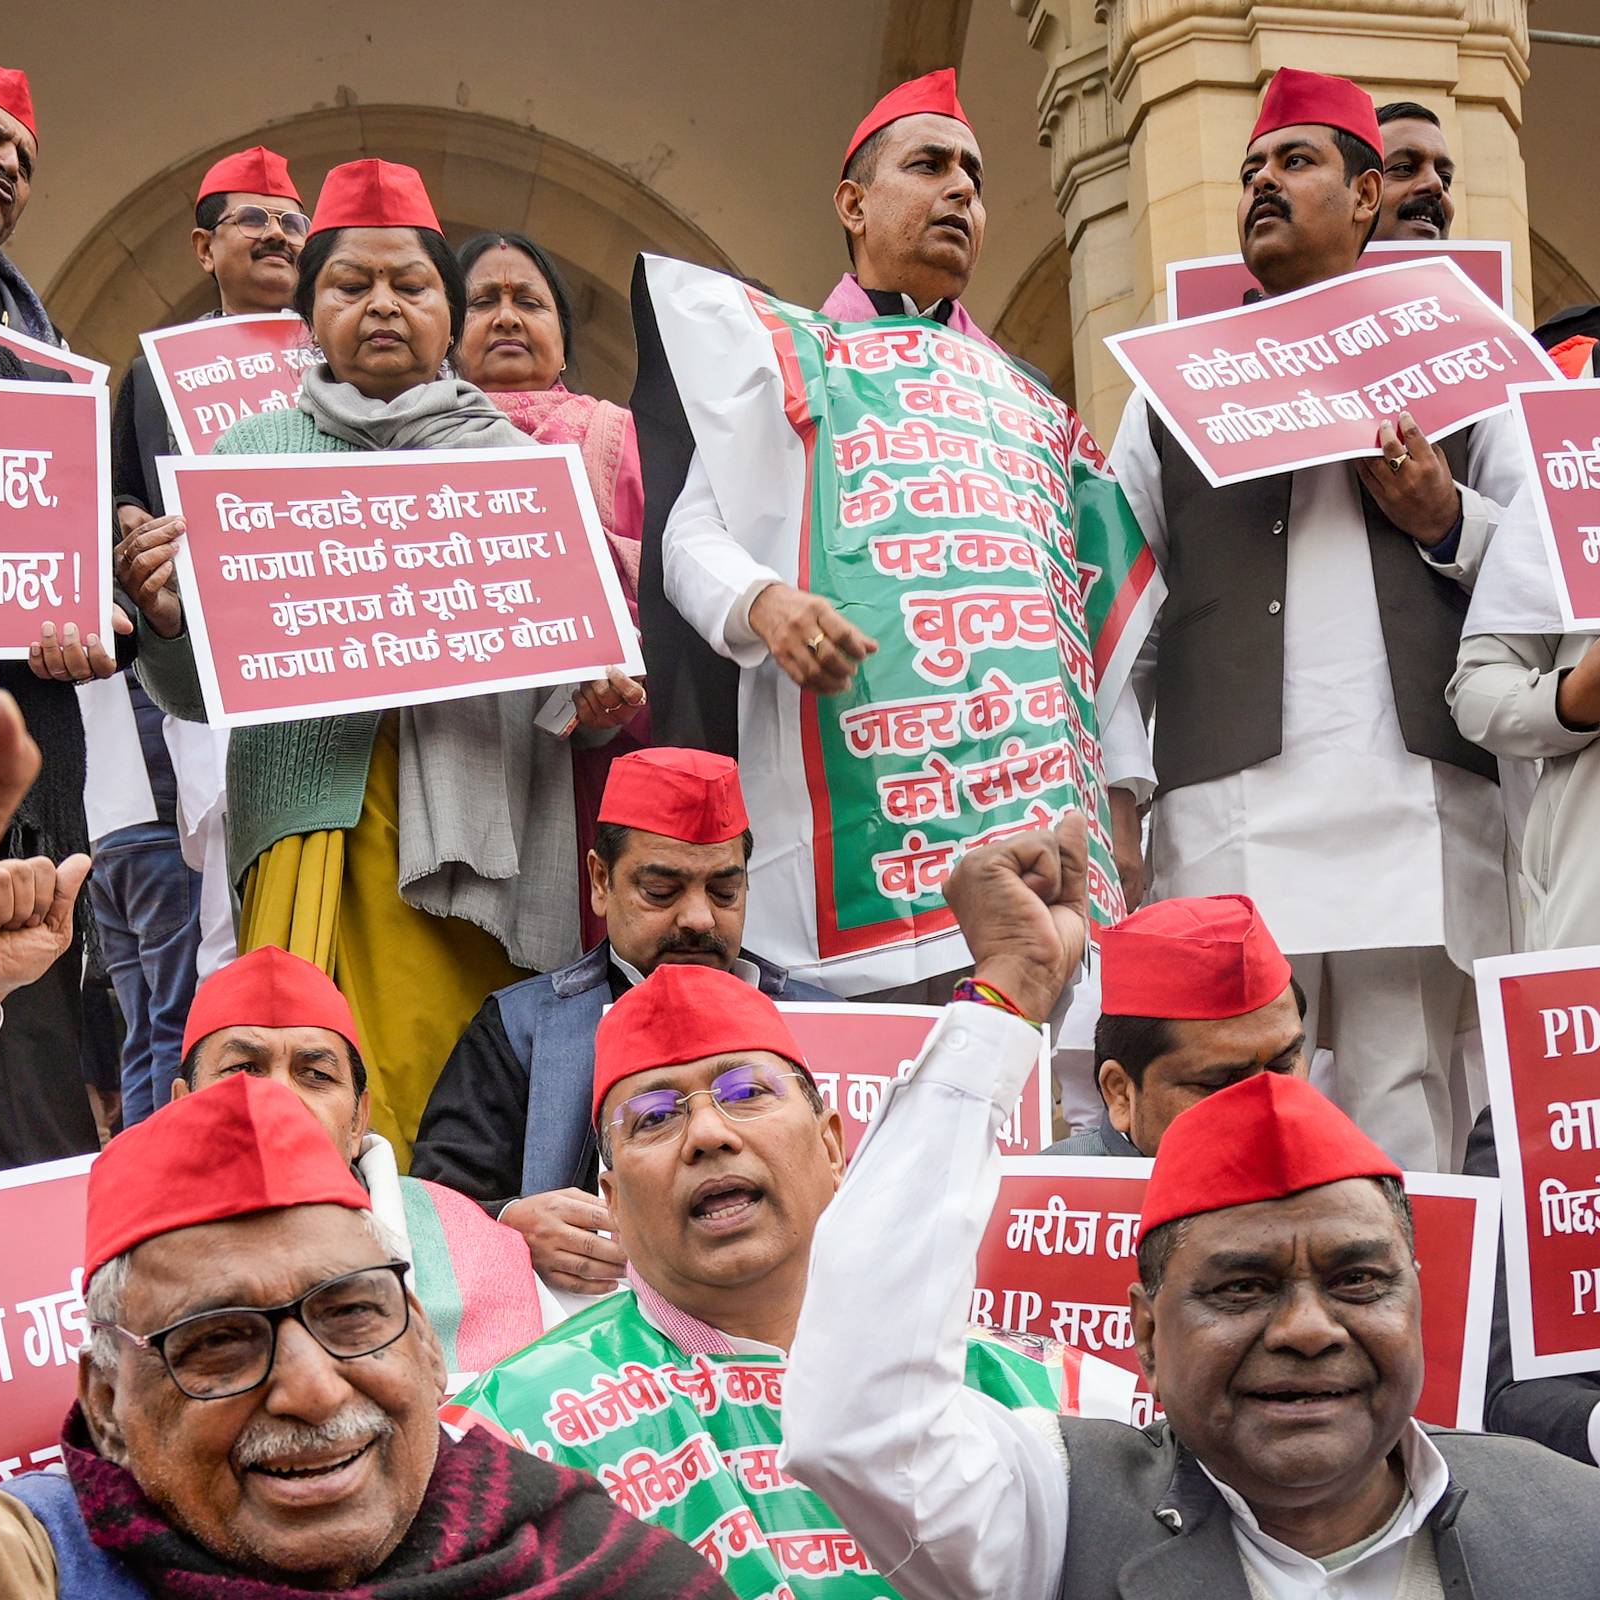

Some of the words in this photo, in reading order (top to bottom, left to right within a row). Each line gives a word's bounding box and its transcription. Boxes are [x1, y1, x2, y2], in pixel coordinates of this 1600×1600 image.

[1176, 348, 1270, 390] कोडीन
[1256, 335, 1339, 377] सिरप
[1329, 315, 1390, 356] बना
[1380, 296, 1460, 338] जहर,
[1198, 389, 1336, 444] माफियाओं
[1324, 390, 1374, 422] का
[368, 495, 419, 530] लूट
[426, 485, 482, 519] और
[843, 475, 893, 524] के
[220, 551, 315, 581] भाजपा
[319, 539, 387, 576] सिर्फ
[392, 532, 473, 568] करती
[875, 536, 943, 573] पर
[270, 593, 383, 635] गुंडाराज
[387, 583, 416, 616] में
[419, 579, 477, 620] यूपी
[239, 647, 335, 679] भाजपा
[340, 637, 368, 668] ने
[372, 629, 440, 666] सिर्फ
[846, 701, 956, 750] जहर
[966, 674, 1013, 732] के
[882, 758, 955, 817] को
[1007, 1195, 1101, 1258] मरीज
[549, 1366, 666, 1440] बीजेपी
